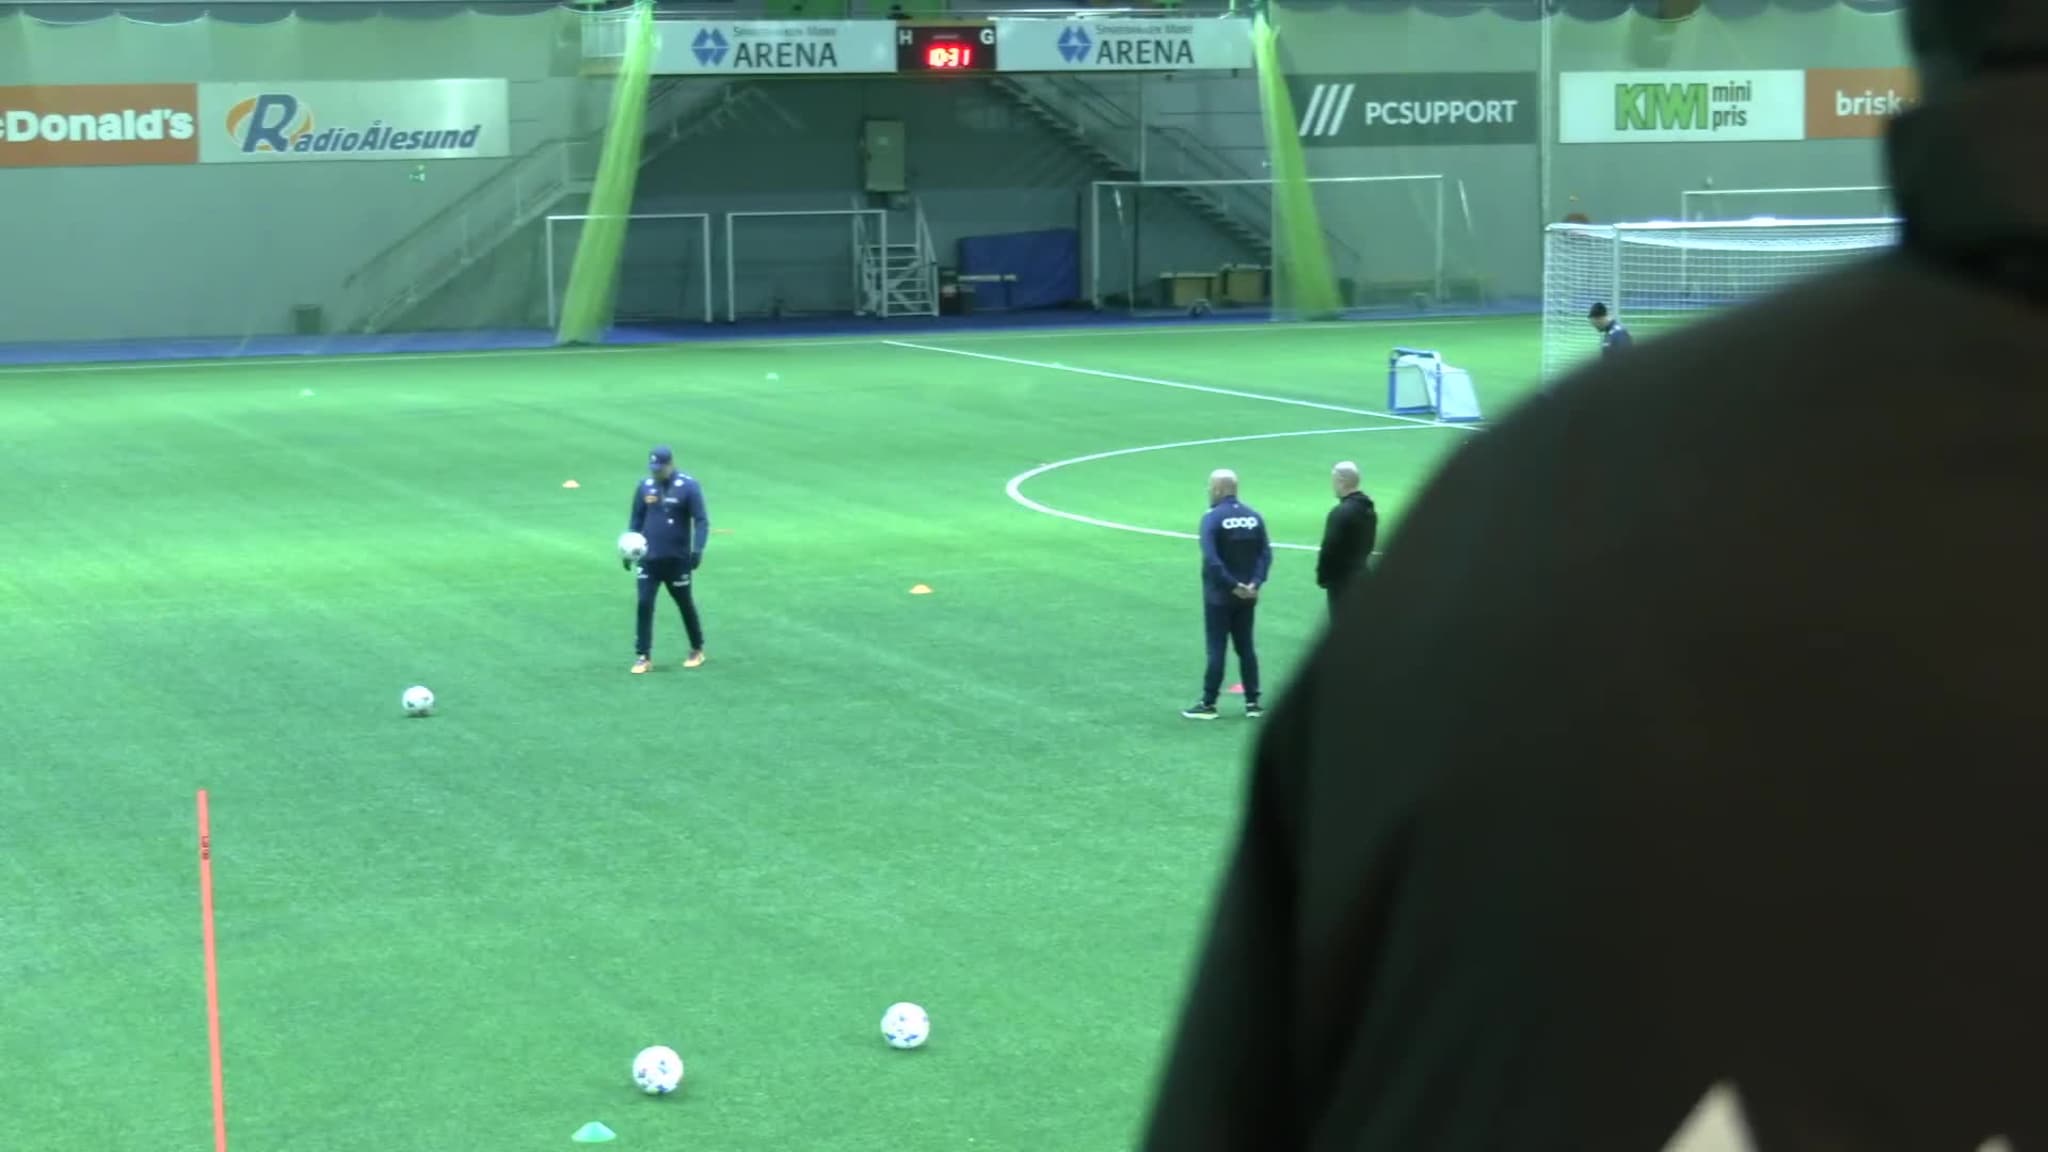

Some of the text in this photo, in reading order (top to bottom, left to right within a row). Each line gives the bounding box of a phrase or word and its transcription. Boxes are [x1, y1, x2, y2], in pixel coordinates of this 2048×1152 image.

[900, 29, 913, 46] H
[980, 28, 995, 46] G
[733, 42, 838, 68] ARENA
[1095, 39, 1195, 64] ARENA
[1711, 80, 1752, 103] mini
[1364, 99, 1518, 126] PCSUPPORT
[1615, 82, 1709, 131] KIWI
[1711, 105, 1748, 131] pris
[0, 109, 195, 142] Donald's
[1222, 516, 1258, 530] coop
